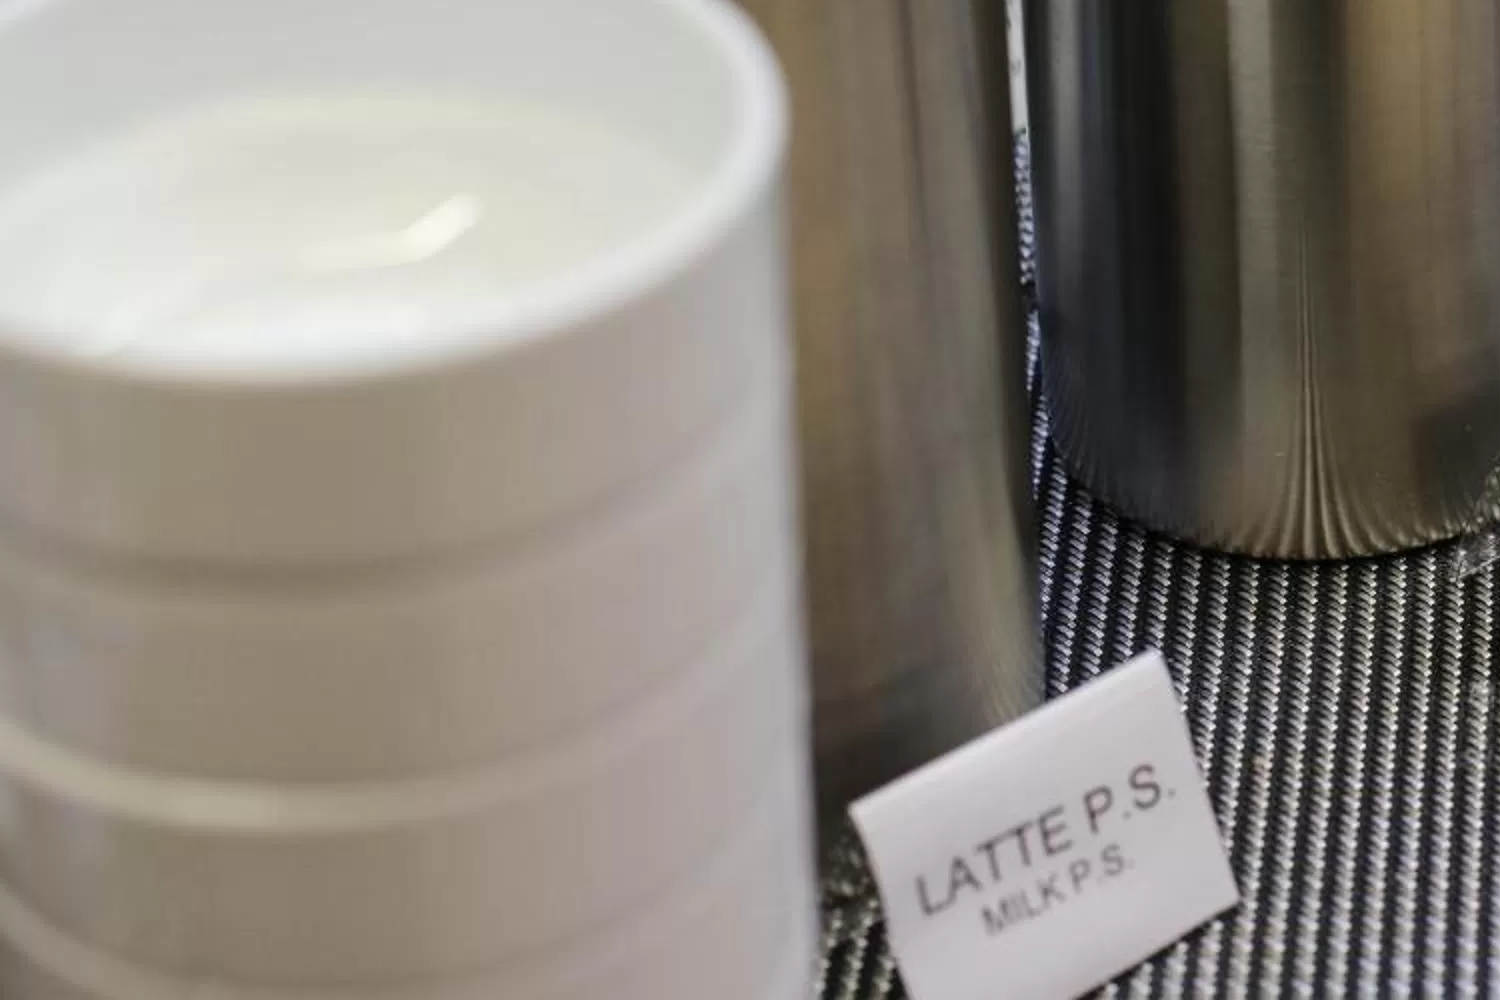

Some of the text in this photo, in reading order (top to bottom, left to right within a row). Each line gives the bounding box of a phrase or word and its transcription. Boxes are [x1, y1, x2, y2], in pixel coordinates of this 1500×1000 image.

[914, 763, 1176, 917] LATTE P.S.
[980, 875, 1065, 936] MILK
